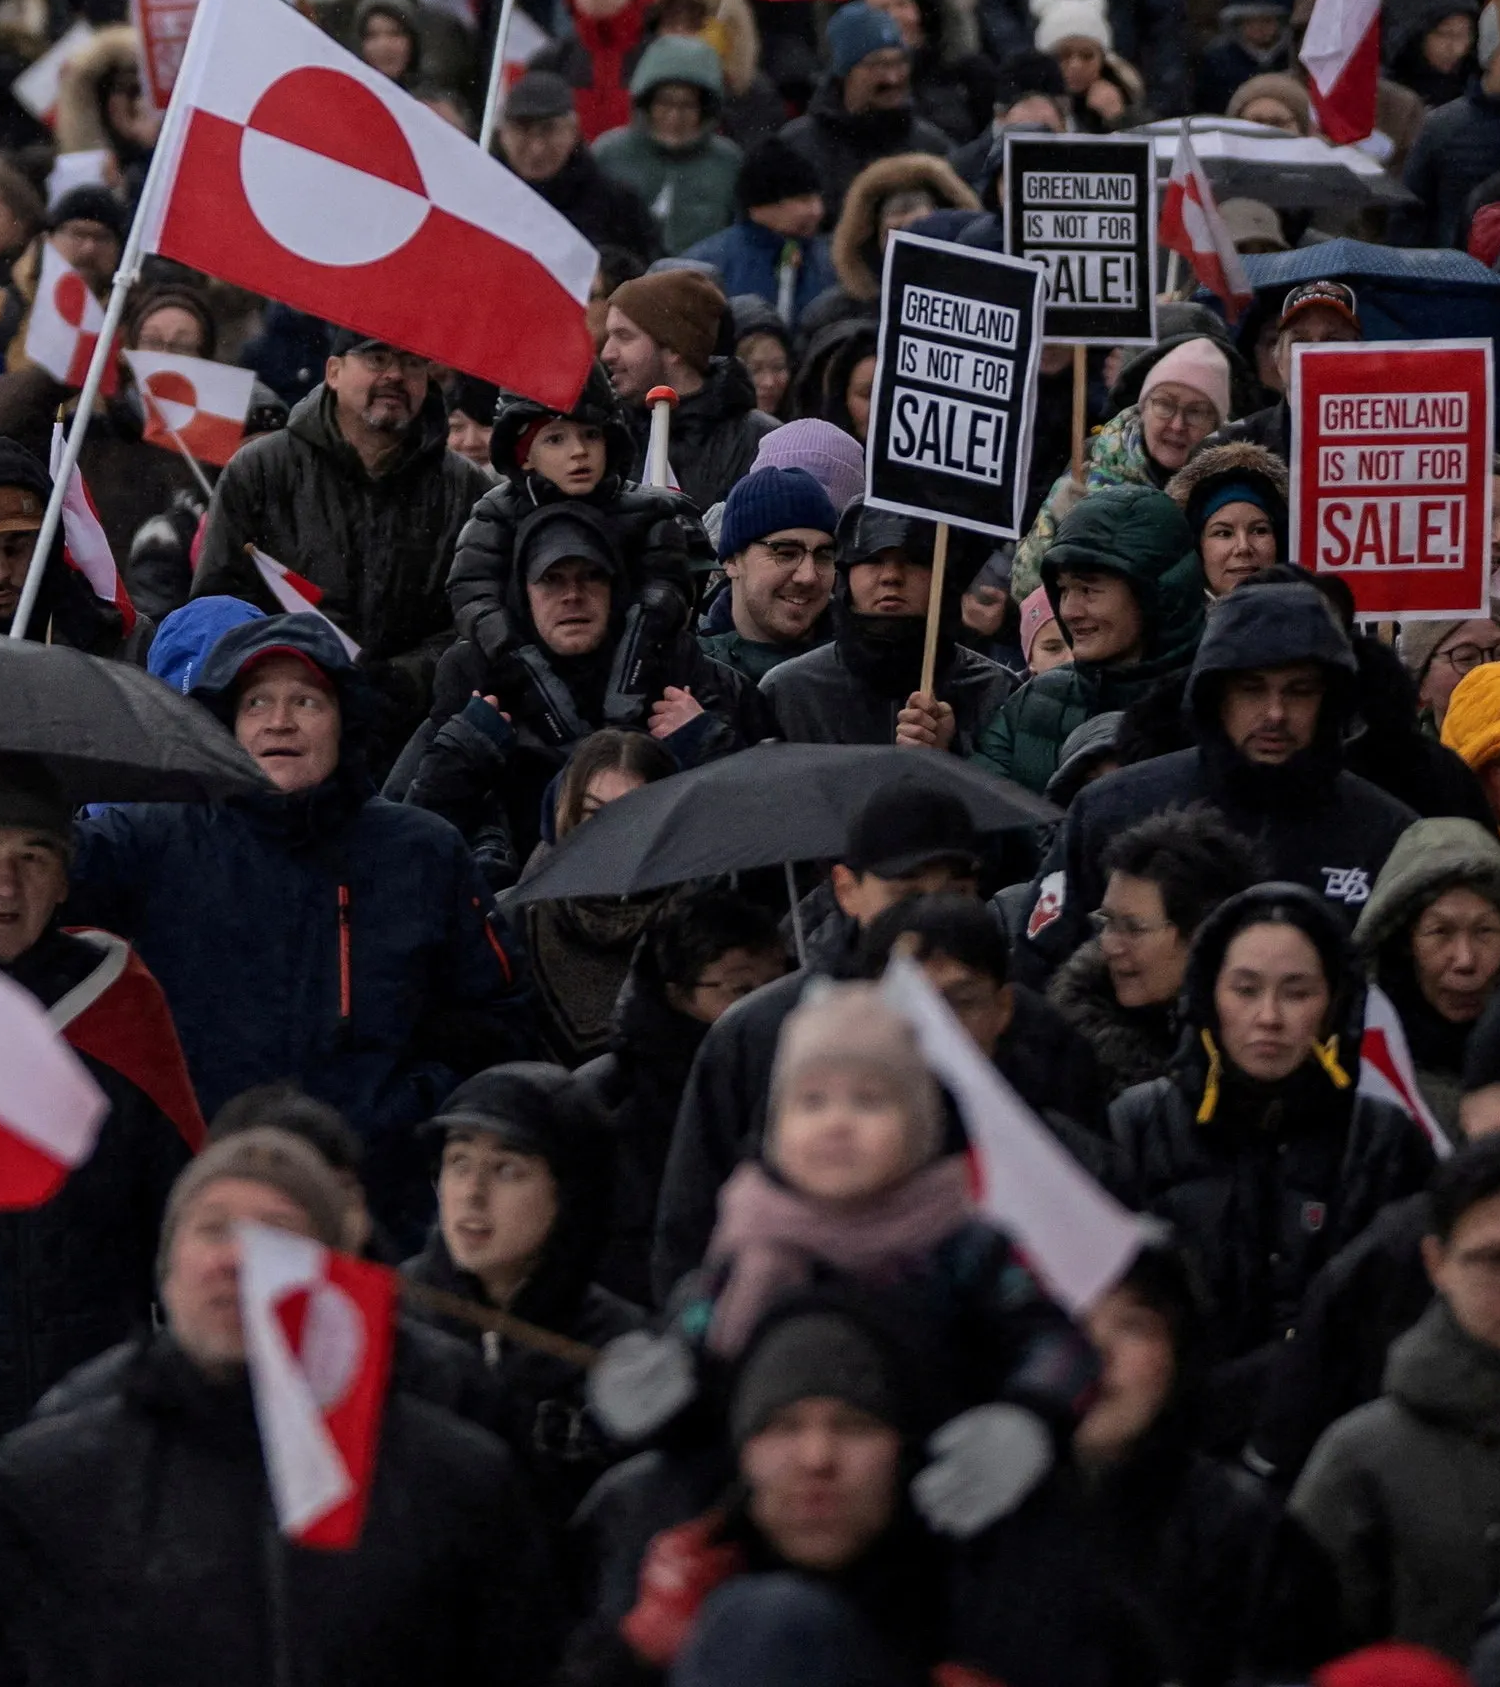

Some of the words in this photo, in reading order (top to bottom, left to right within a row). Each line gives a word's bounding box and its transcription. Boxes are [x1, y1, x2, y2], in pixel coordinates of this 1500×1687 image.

[1027, 175, 1132, 202] GREENLAND
[1027, 214, 1044, 238] IS
[1053, 215, 1088, 240] NOT
[1098, 216, 1132, 241] FOR
[905, 291, 1015, 343] GREENLAND
[901, 341, 917, 374] IS
[927, 347, 964, 384] NOT
[972, 358, 1008, 395] FOR
[1323, 397, 1463, 431] GREENLAND
[893, 393, 1004, 479] SALE!
[1323, 451, 1345, 482] IS
[1357, 450, 1405, 481] NOT
[1417, 448, 1462, 480] FOR
[1321, 500, 1462, 567] SALE!
